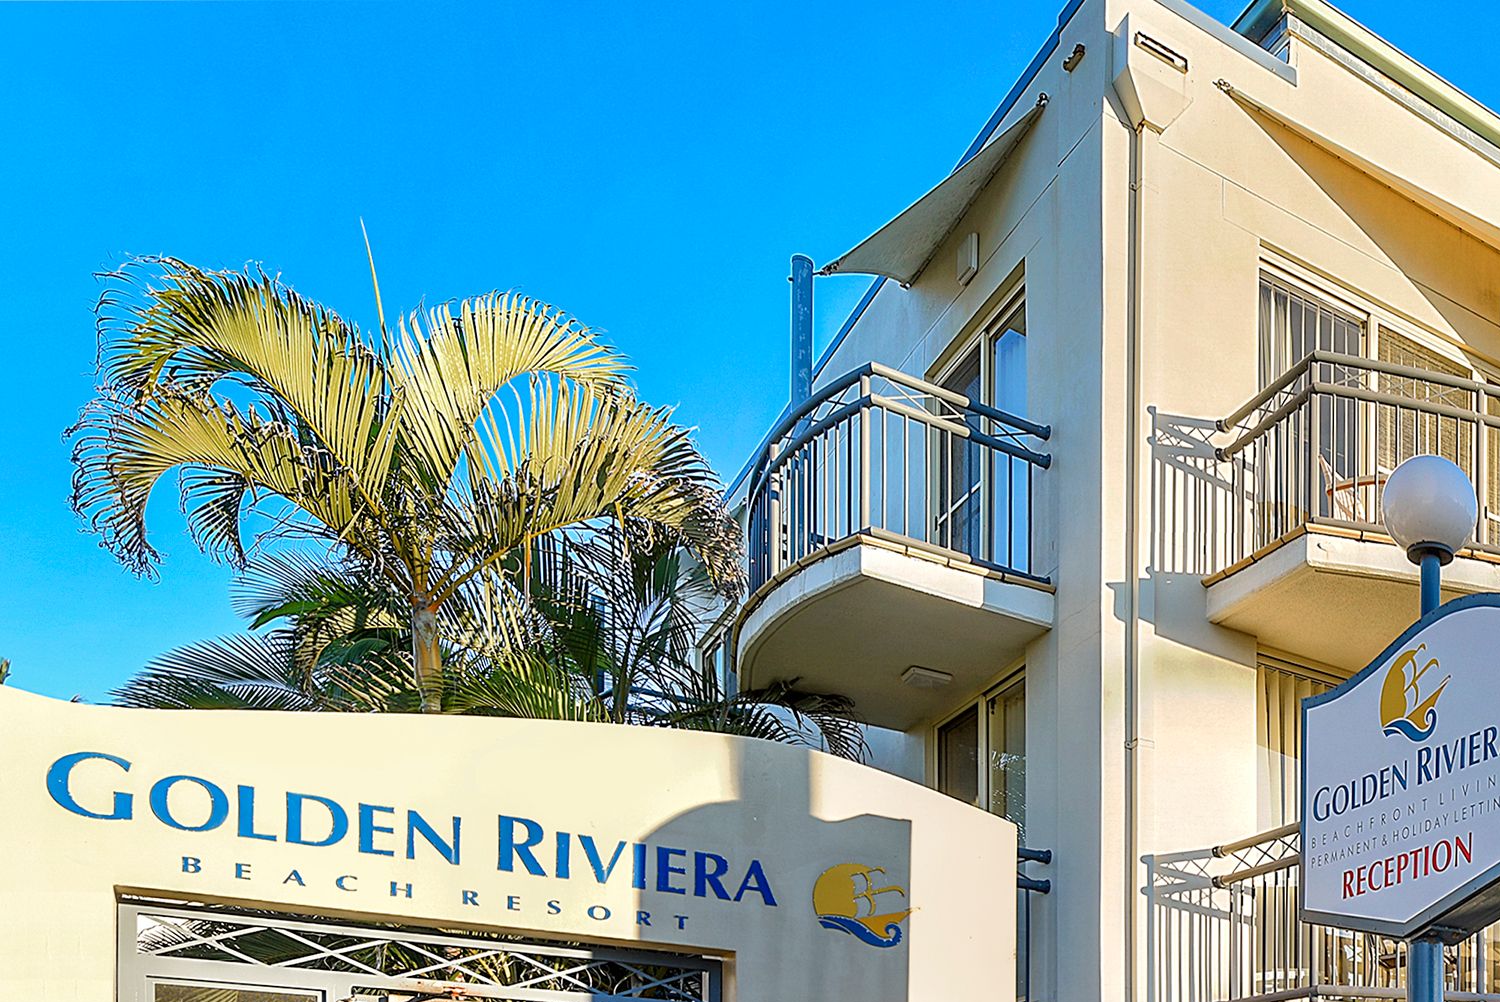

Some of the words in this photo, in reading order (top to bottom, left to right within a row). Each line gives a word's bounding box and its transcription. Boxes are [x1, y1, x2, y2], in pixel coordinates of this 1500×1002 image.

[1311, 798, 1429, 850] BEACHFRONT
[1312, 760, 1409, 823] GOLDEN
[47, 751, 462, 866] GOLDEN
[498, 815, 779, 908] RIVIERA
[1311, 837, 1378, 869] PERMANENT
[1381, 833, 1389, 847] &
[1392, 813, 1450, 843] HOLIDAY
[181, 855, 414, 898] BEACH
[462, 888, 690, 931] RESORT
[1341, 831, 1474, 900] RECEPTION
